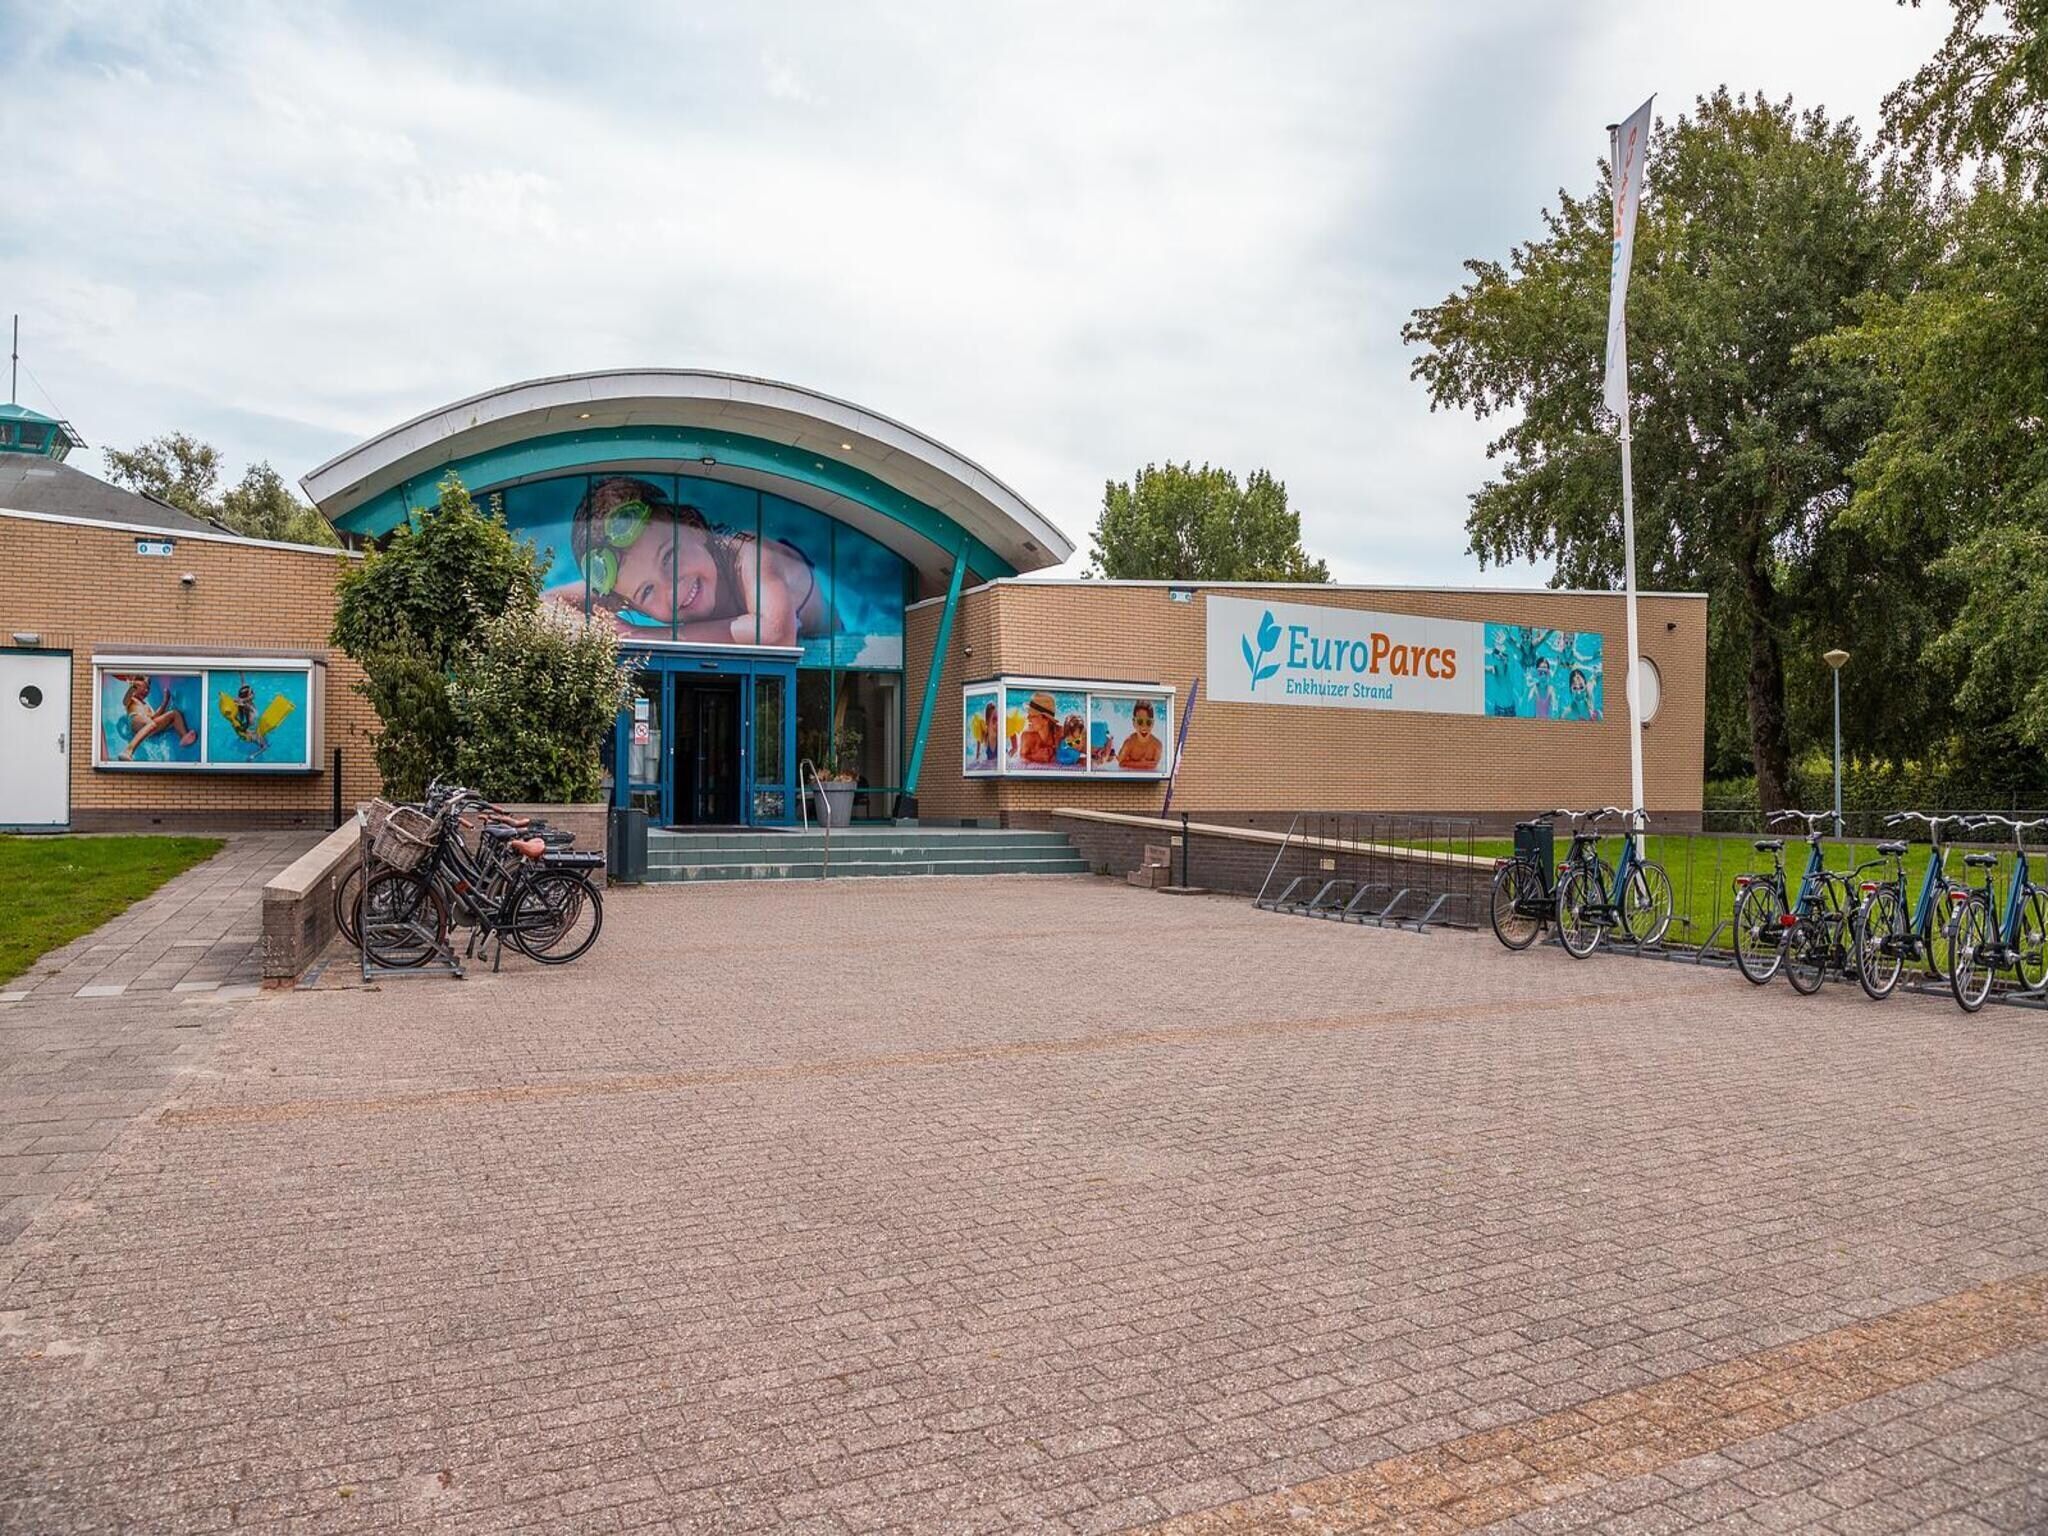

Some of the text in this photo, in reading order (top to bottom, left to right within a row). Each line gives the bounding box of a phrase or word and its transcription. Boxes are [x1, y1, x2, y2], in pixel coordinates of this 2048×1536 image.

[1287, 625, 1456, 679] EuroParcs
[1286, 678, 1393, 700] Enkhuizer Strand
